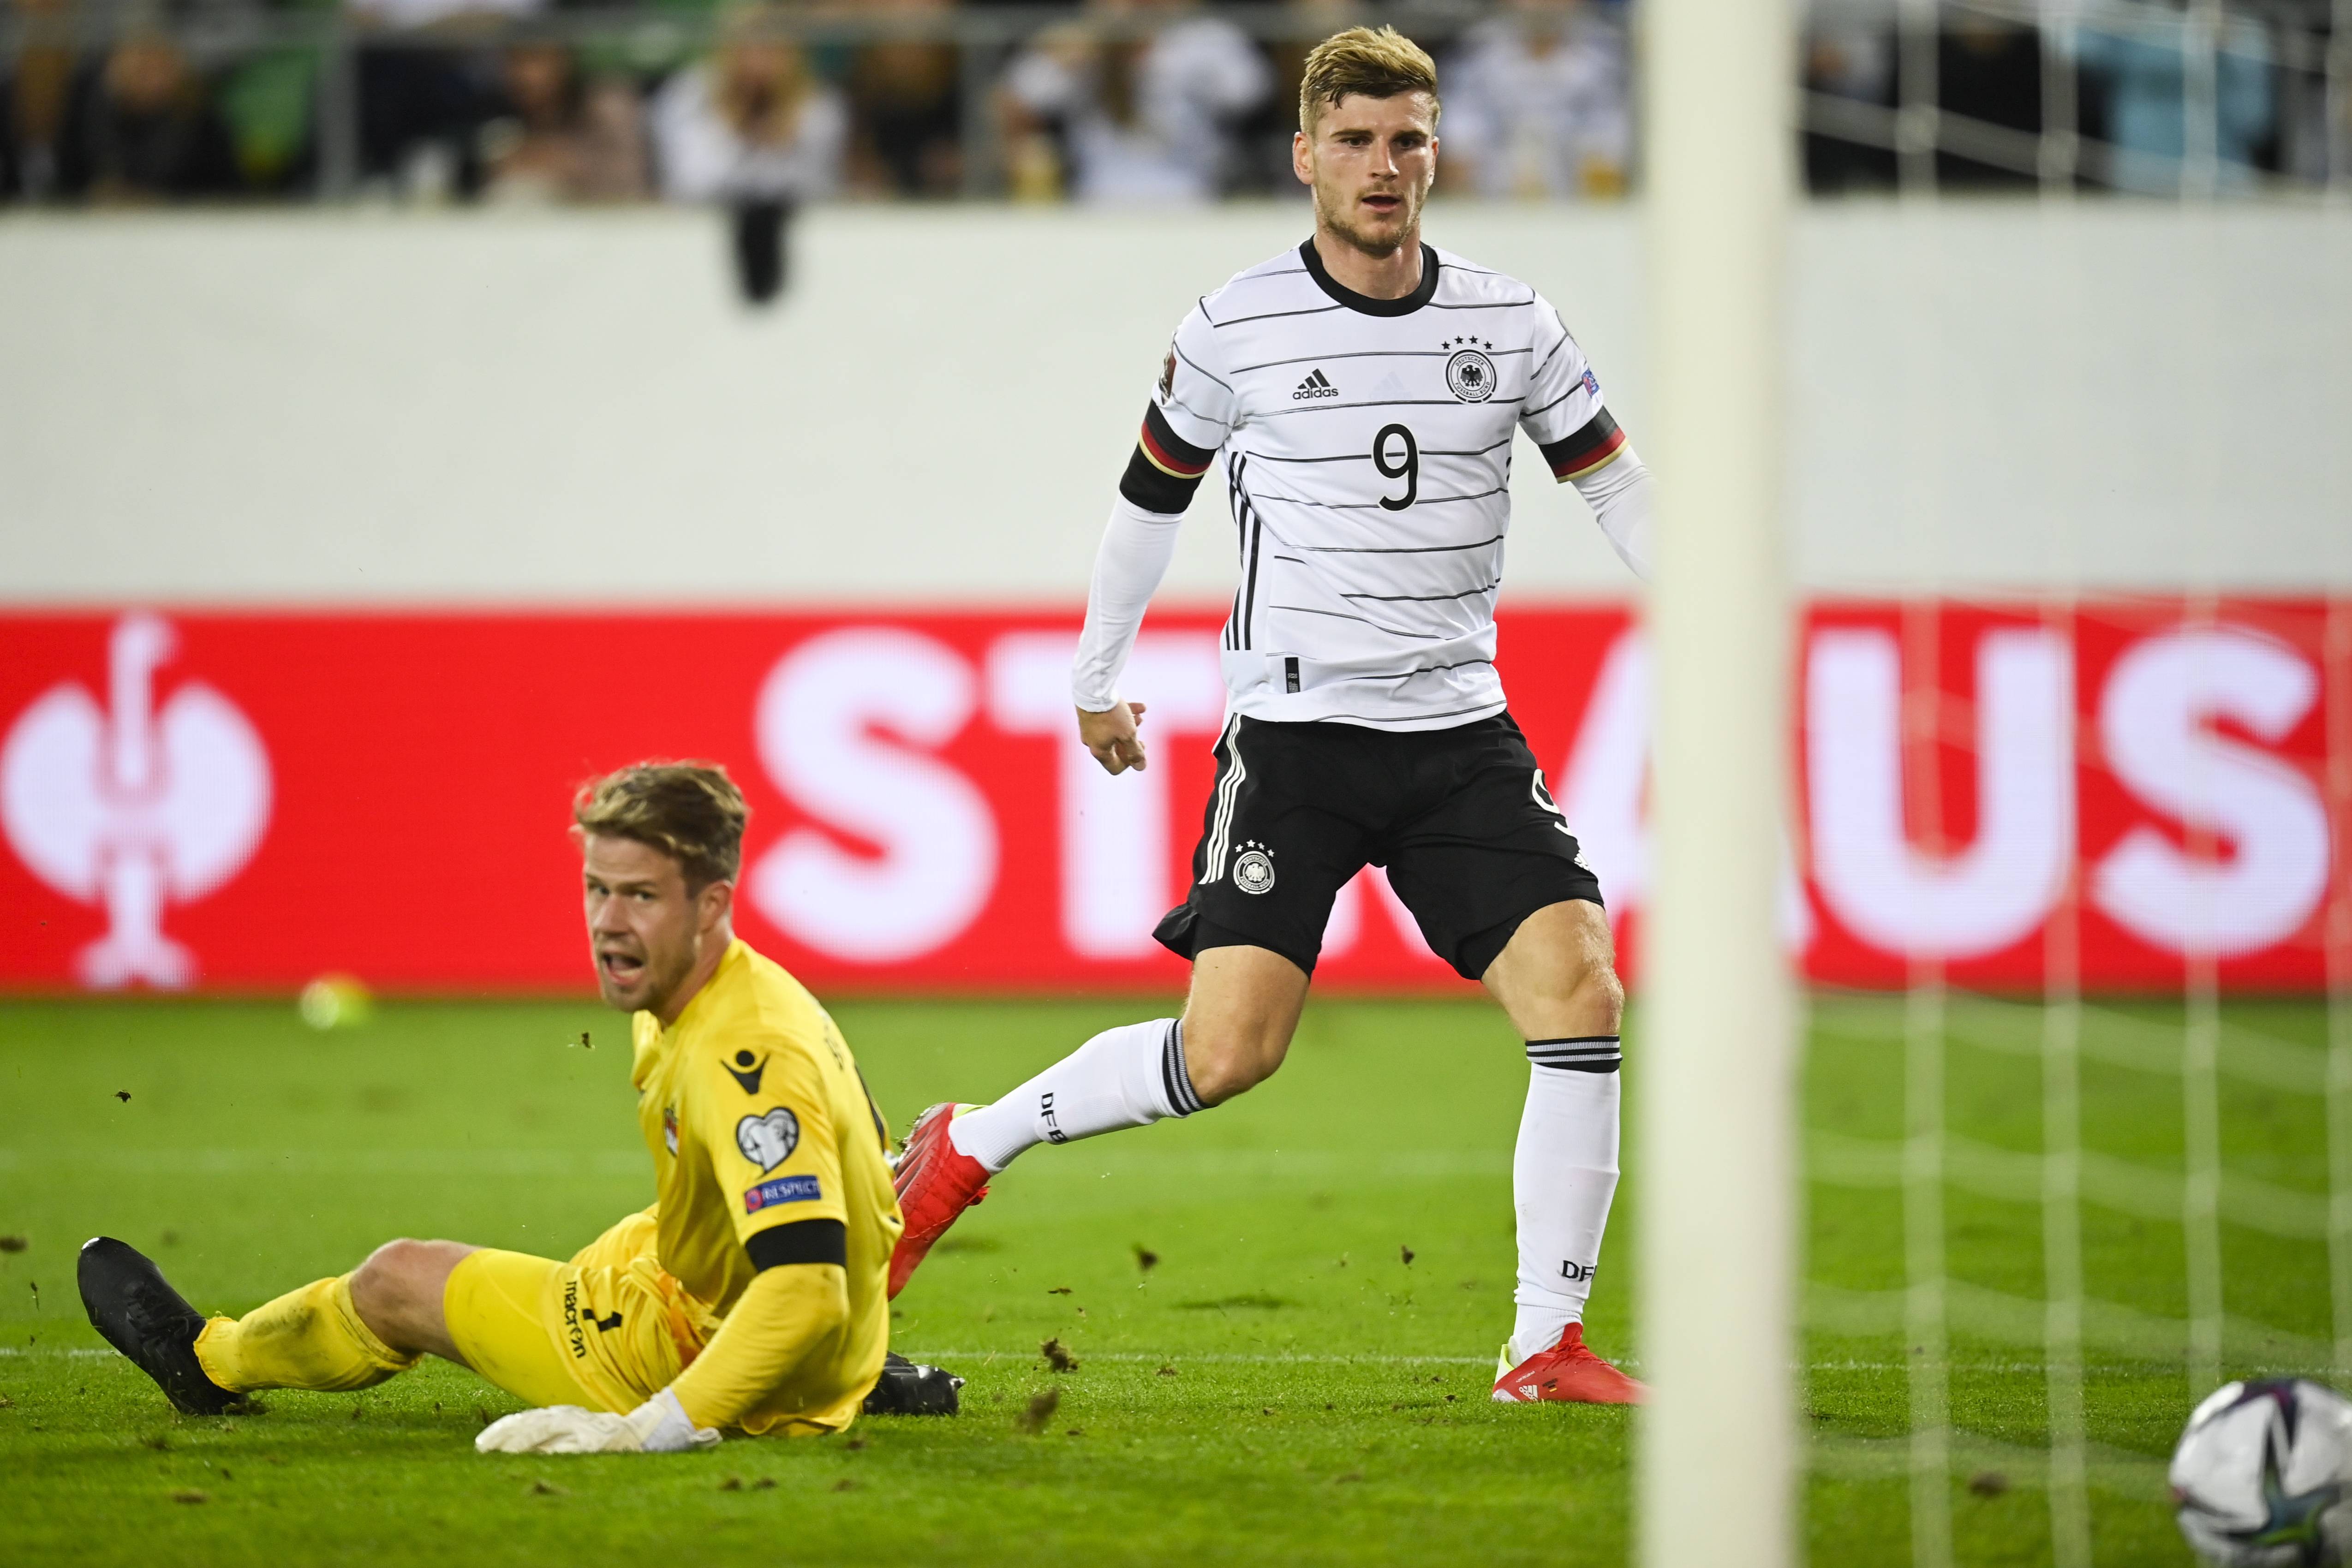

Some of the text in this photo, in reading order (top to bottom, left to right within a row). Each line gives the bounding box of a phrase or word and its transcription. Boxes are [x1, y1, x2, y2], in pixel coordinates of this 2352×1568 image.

[1455, 356, 1484, 366] DEUTSCHER
[1292, 388, 1339, 400] adidas
[1373, 423, 1419, 511] 9
[1041, 1092, 1069, 1142] DFB
[1561, 1260, 1597, 1282] DF
[564, 1281, 586, 1358] macron
[1518, 1386, 1539, 1403] adida
